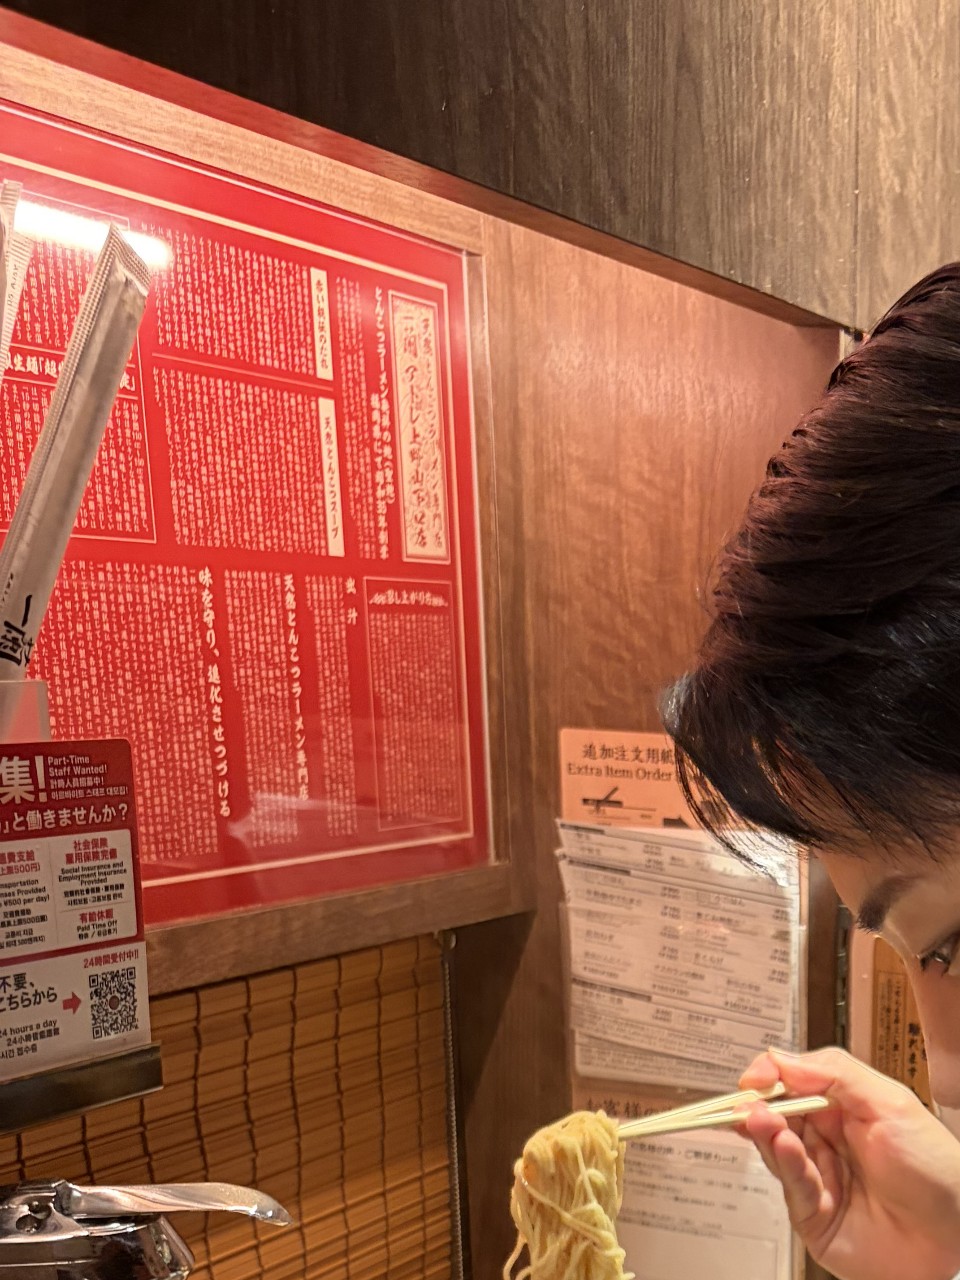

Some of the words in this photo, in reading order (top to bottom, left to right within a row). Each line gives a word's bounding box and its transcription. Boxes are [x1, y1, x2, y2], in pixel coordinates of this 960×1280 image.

[323, 416, 340, 540] 天然とんこつスープ
[284, 573, 309, 800] 天然とんこつラーメン専門店
[48, 754, 90, 766] Part-Time
[49, 766, 71, 777] Staff
[73, 764, 108, 775] Wanted!
[567, 763, 602, 777] Extra
[605, 765, 633, 780] Item
[635, 767, 672, 782] Order
[0, 803, 128, 834] 」と働きませんか?
[60, 864, 80, 875] Social
[81, 862, 112, 873] Insurance
[58, 871, 97, 883] Employment
[80, 877, 108, 887] Provided
[9, 1023, 34, 1035] hours
